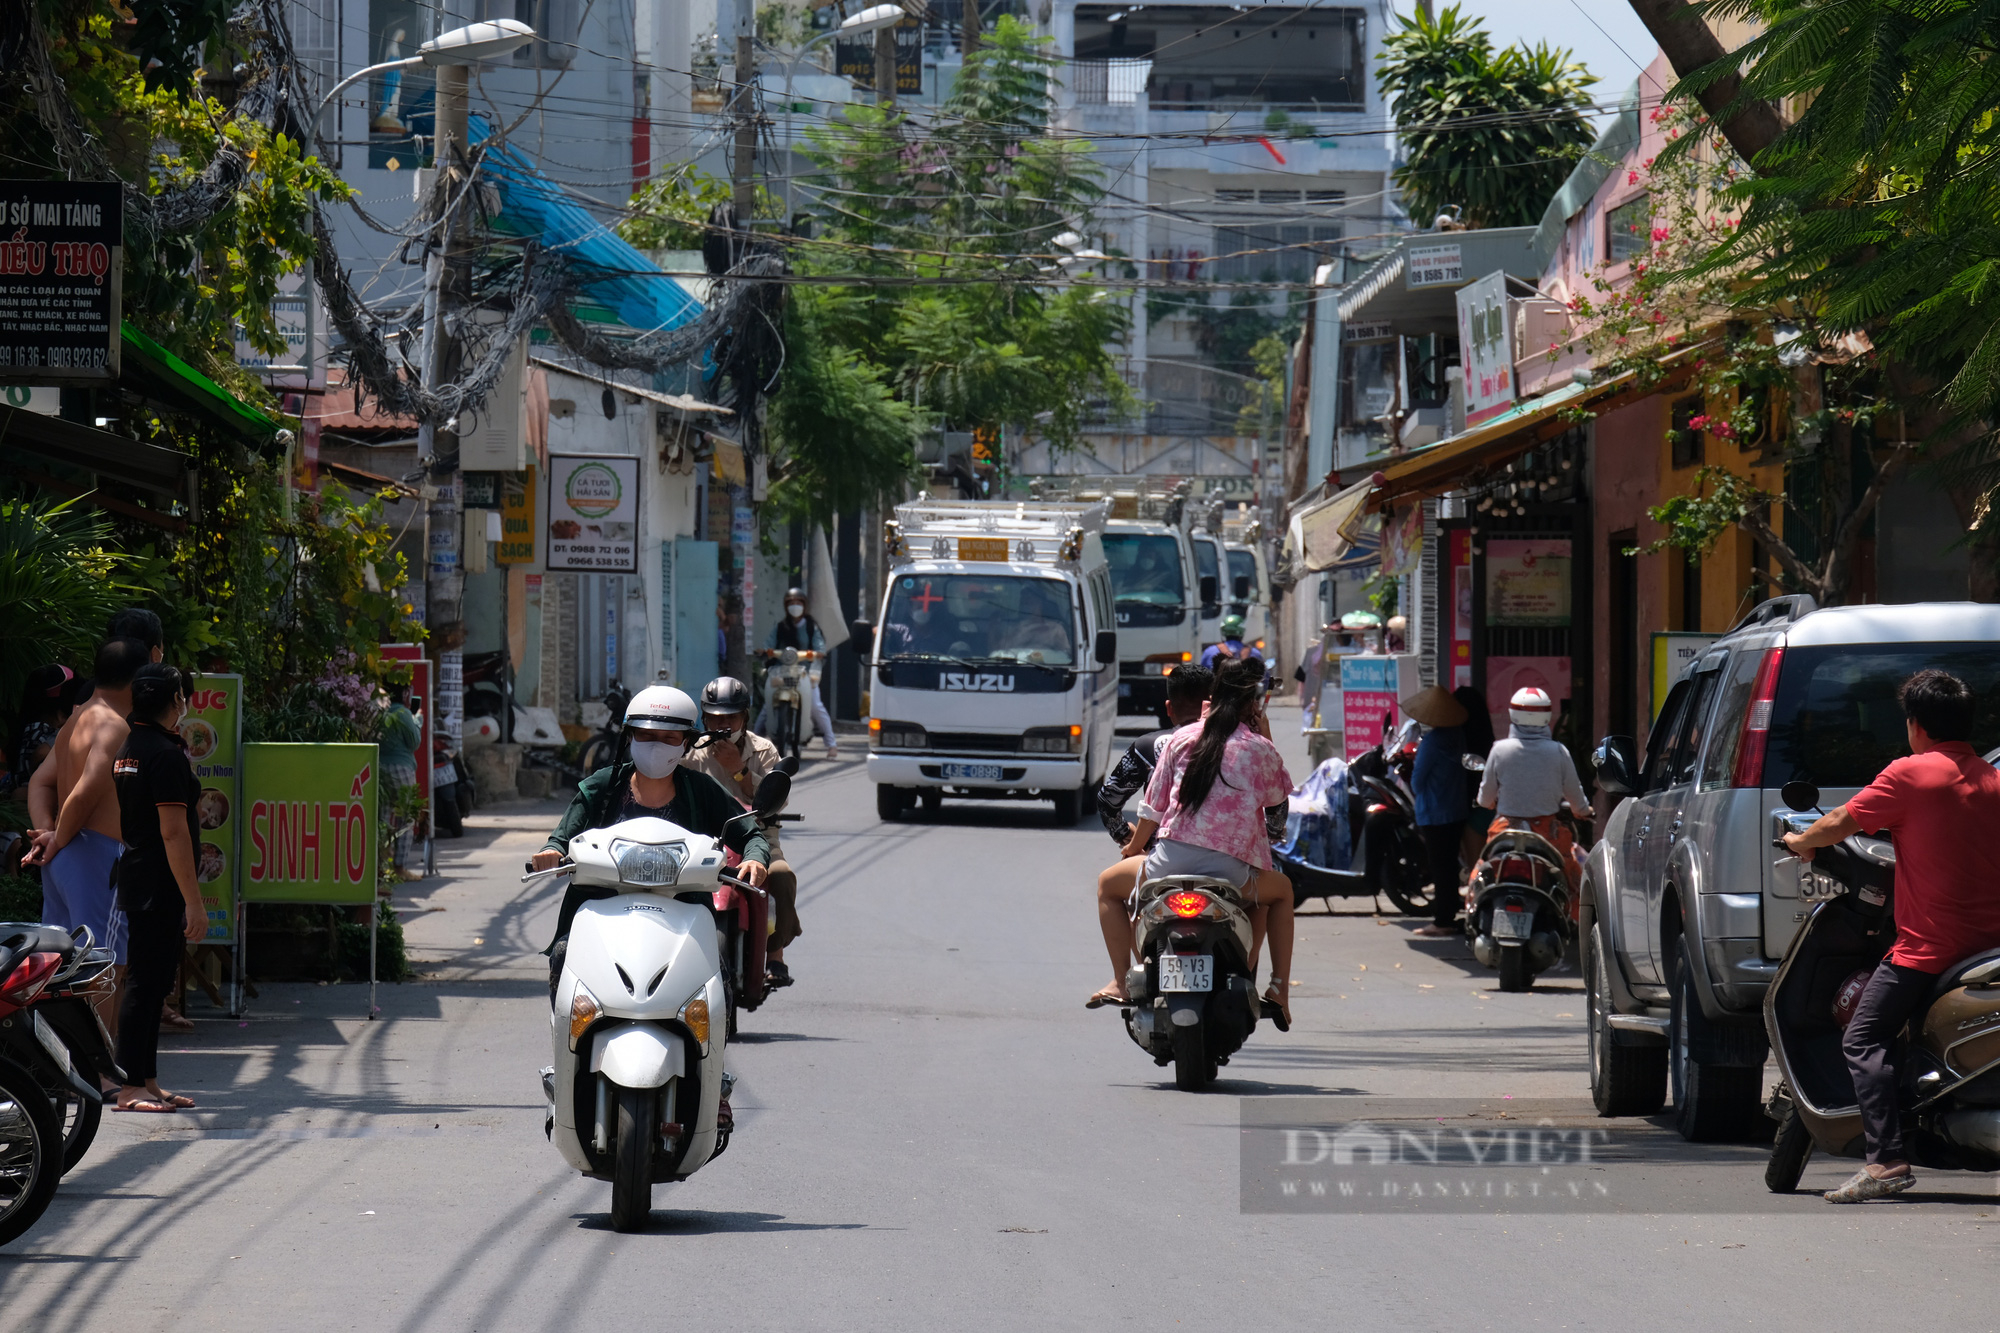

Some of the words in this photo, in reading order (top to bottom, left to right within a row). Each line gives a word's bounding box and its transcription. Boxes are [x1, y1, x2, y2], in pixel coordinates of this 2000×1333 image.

[10, 195, 30, 225] SỞ
[33, 203, 60, 226] MAI
[65, 199, 101, 227] TÁNG
[52, 242, 109, 286] THỌ
[10, 285, 30, 294] CÁC
[33, 286, 55, 296] LOẠI
[58, 285, 71, 295] ÁO
[74, 287, 101, 296] QUAN
[53, 297, 70, 307] CÁC
[22, 311, 33, 319] XE
[66, 312, 77, 320] XE
[20, 322, 42, 332] NHẠC
[65, 324, 87, 333] NHẠC
[89, 324, 108, 332] NAM
[48, 347, 71, 367] 0903
[73, 347, 91, 368] 923
[570, 545, 595, 553] 0988
[599, 546, 611, 554] 712
[614, 546, 630, 554] 016
[568, 557, 593, 565] 0966
[596, 558, 612, 566] 538
[614, 558, 630, 566] 535
[940, 672, 1015, 691] ISUZU
[190, 689, 227, 715] ỰC
[197, 764, 211, 777] Quy
[213, 765, 233, 777] Nhơn
[250, 799, 321, 882] SINH
[328, 762, 371, 884] TỐ
[1168, 958, 1205, 973] 59-V3
[1163, 974, 1209, 989] 214.45
[1839, 980, 1862, 1009] LEO
